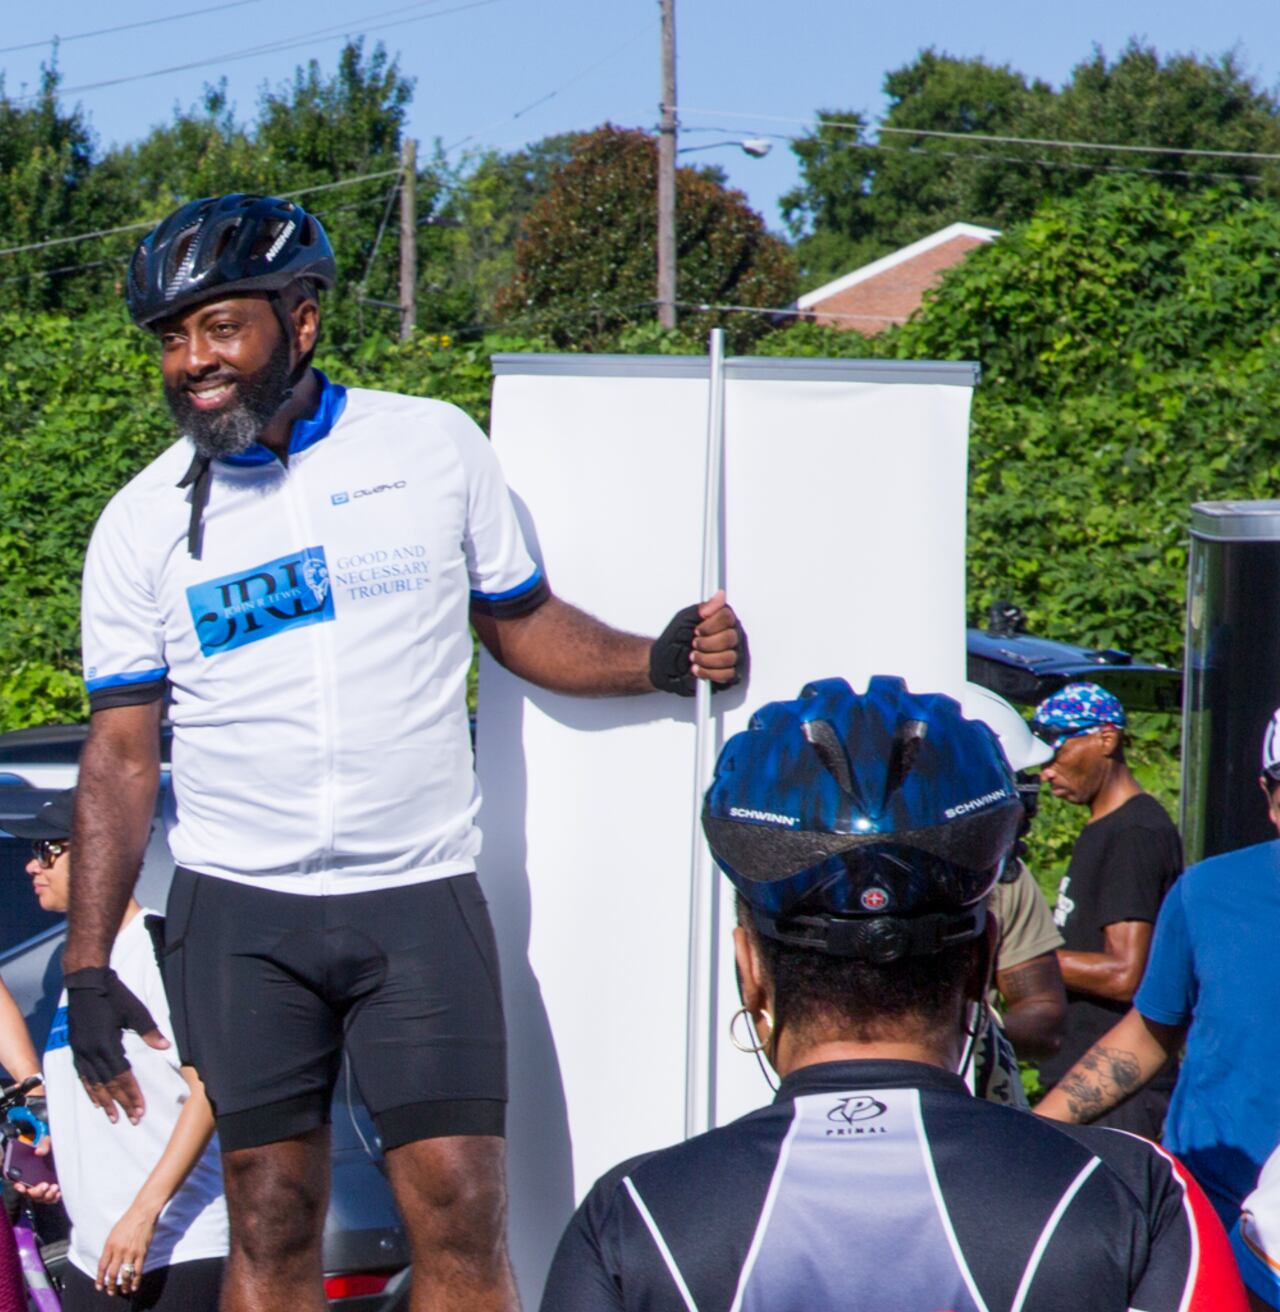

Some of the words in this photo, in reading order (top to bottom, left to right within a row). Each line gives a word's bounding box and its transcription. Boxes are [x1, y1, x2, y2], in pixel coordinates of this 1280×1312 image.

[336, 549, 388, 570] GOOD
[392, 544, 427, 561] AND
[335, 560, 431, 587] NECESSARY
[729, 807, 794, 826] SCHWINN
[944, 789, 1006, 820] SCHWINN
[825, 1125, 888, 1137] PRIMAL
